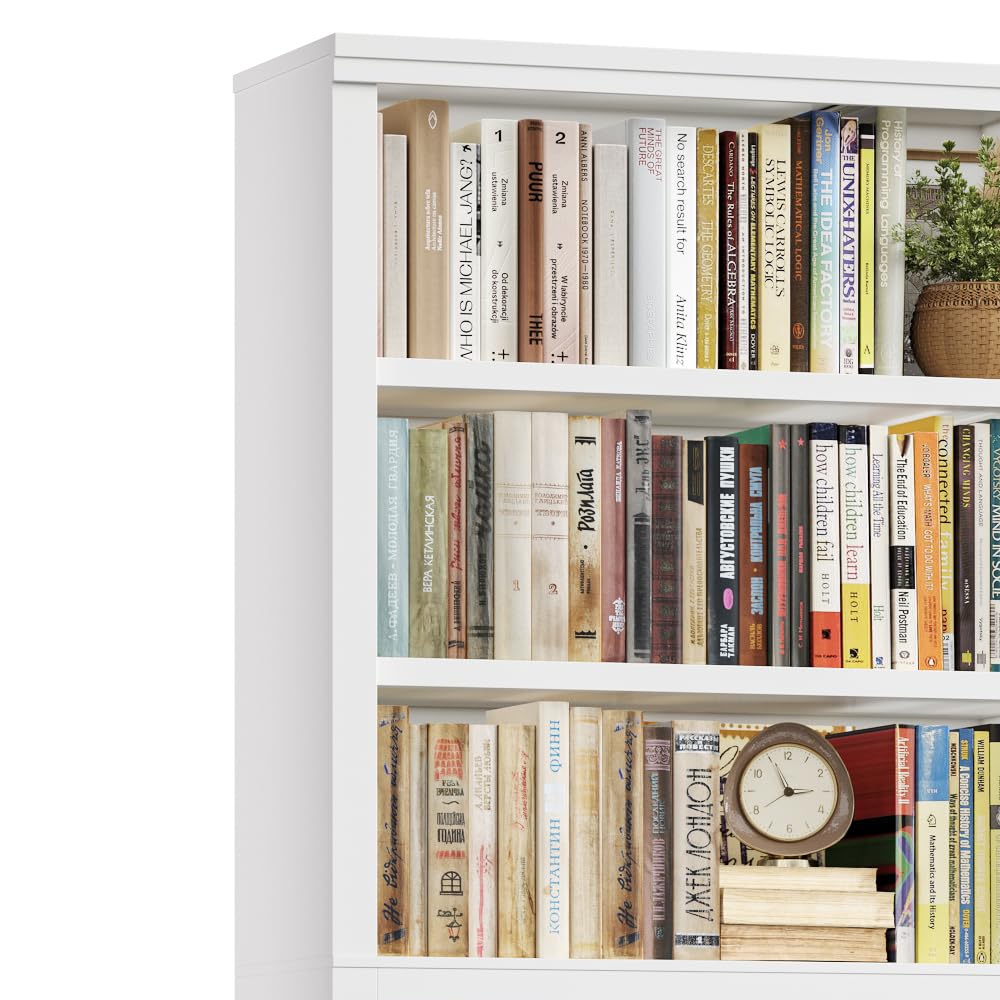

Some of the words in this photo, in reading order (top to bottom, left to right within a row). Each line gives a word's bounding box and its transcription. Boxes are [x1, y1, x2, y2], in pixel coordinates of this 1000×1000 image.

[495, 130, 502, 142] 1
[556, 132, 566, 144] 2
[639, 128, 647, 166] FUTURE
[647, 128, 655, 158] MINDS
[655, 129, 663, 144] THE
[677, 134, 687, 150] No
[647, 162, 655, 174] OF
[655, 147, 663, 182] GREAT
[677, 154, 687, 196] search
[880, 120, 891, 209] Programming
[459, 159, 473, 215] JANG?
[529, 160, 543, 204] PUUR
[764, 158, 775, 237] SYMBOLIC
[820, 168, 832, 207] THE
[677, 200, 687, 233] result
[842, 162, 856, 298] UNIX-HATERS
[677, 238, 687, 255] for
[820, 211, 832, 256] IDEA
[459, 217, 473, 296] MICHAEL
[764, 241, 775, 288] LOGIC
[880, 214, 891, 288] Languages
[460, 300, 472, 315] IS
[676, 294, 687, 328] Anita
[820, 260, 833, 350] FACTORY
[530, 316, 542, 347] THEE
[676, 334, 688, 365] Klinz
[720, 446, 735, 488] ПУШКИ
[816, 445, 833, 475] how
[897, 457, 906, 472] The
[897, 475, 906, 489] End
[897, 490, 906, 498] of
[816, 479, 834, 536] children
[898, 501, 906, 540] Education
[720, 494, 735, 580] АВГУСТОВСКИЕ
[817, 540, 834, 561] fail
[899, 591, 908, 607] Neil
[899, 610, 908, 643] Postman
[550, 721, 562, 772] ФИНН
[784, 752, 792, 760] 12
[753, 769, 763, 779] 10
[816, 769, 823, 777] 2
[960, 773, 970, 806] Concise
[686, 768, 714, 860] ЛОНДОН
[753, 806, 760, 816] 8
[818, 806, 824, 814] 4
[960, 808, 970, 837] History
[786, 824, 793, 834] 6
[960, 839, 970, 849] of
[549, 819, 560, 934] КОНСТАНТИН
[960, 851, 971, 904] Mathematics
[686, 867, 714, 922] ДЖЕК
